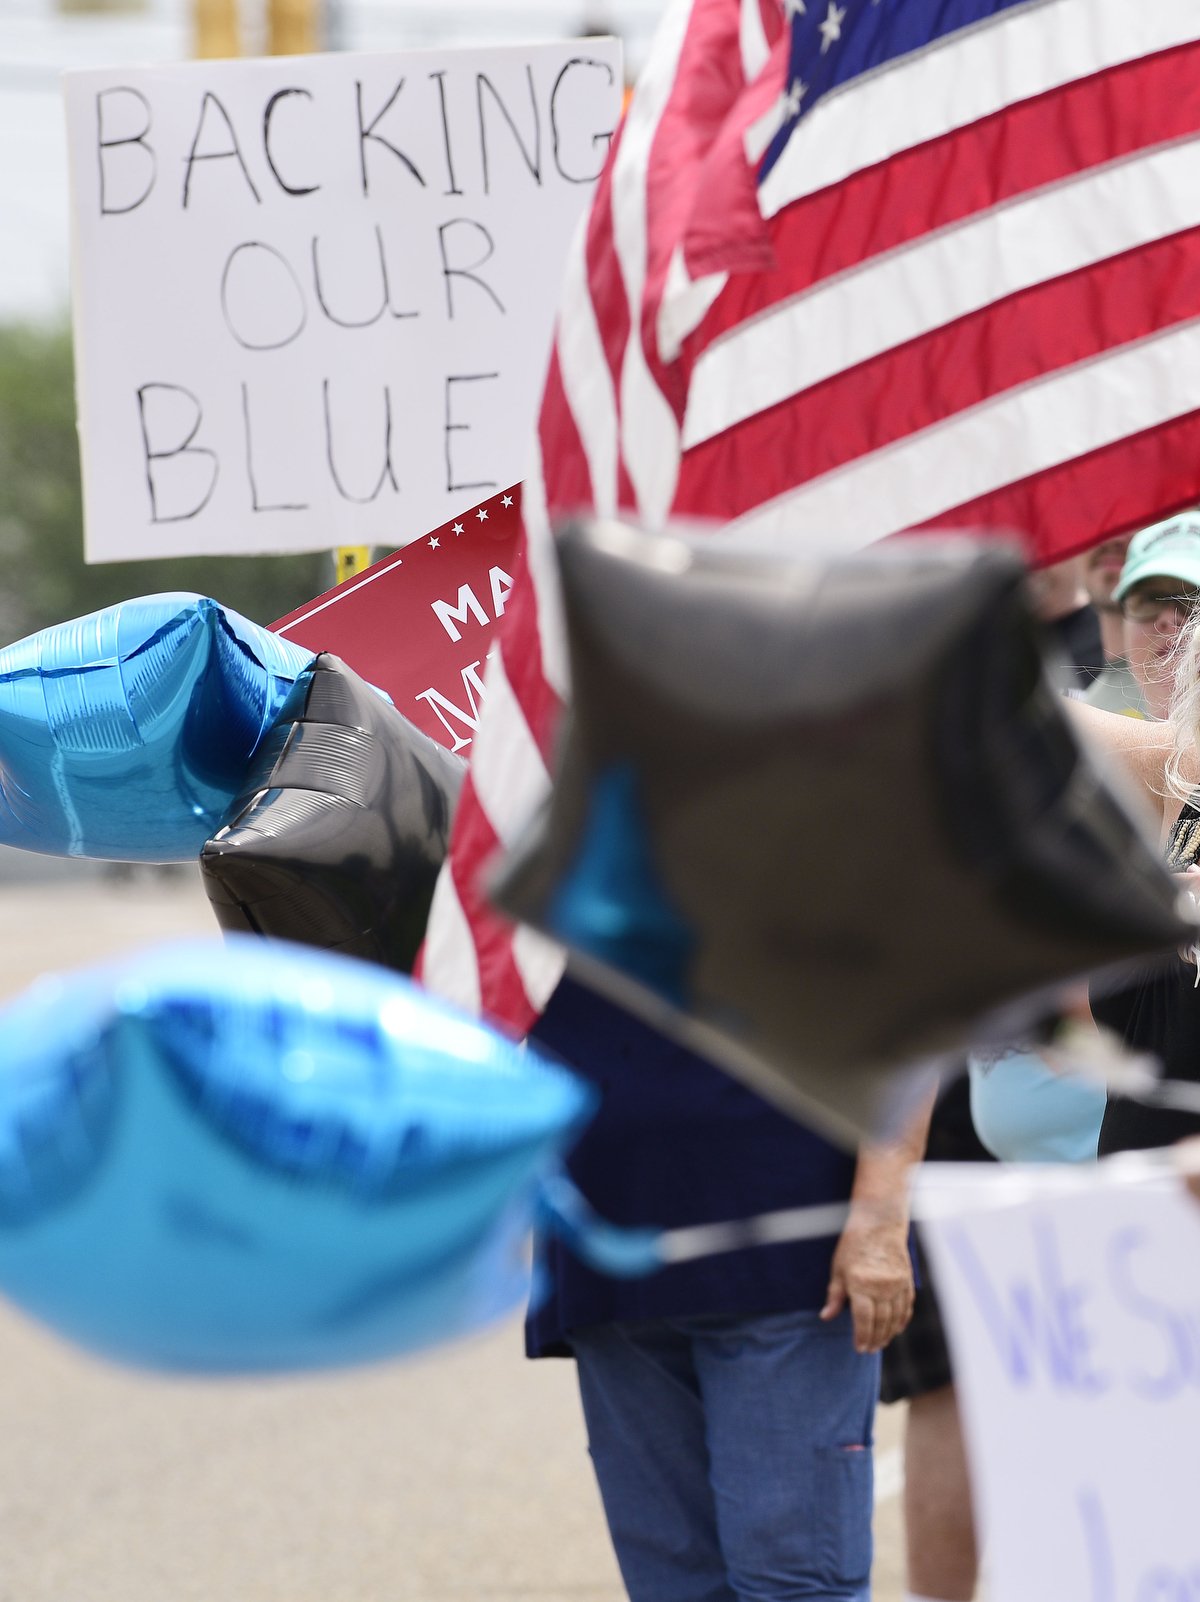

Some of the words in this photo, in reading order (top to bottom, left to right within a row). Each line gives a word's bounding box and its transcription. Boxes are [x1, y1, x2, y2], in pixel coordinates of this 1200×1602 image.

[96, 56, 613, 215] BACKING
[220, 217, 505, 350] OUR
[137, 373, 499, 524] BLUE
